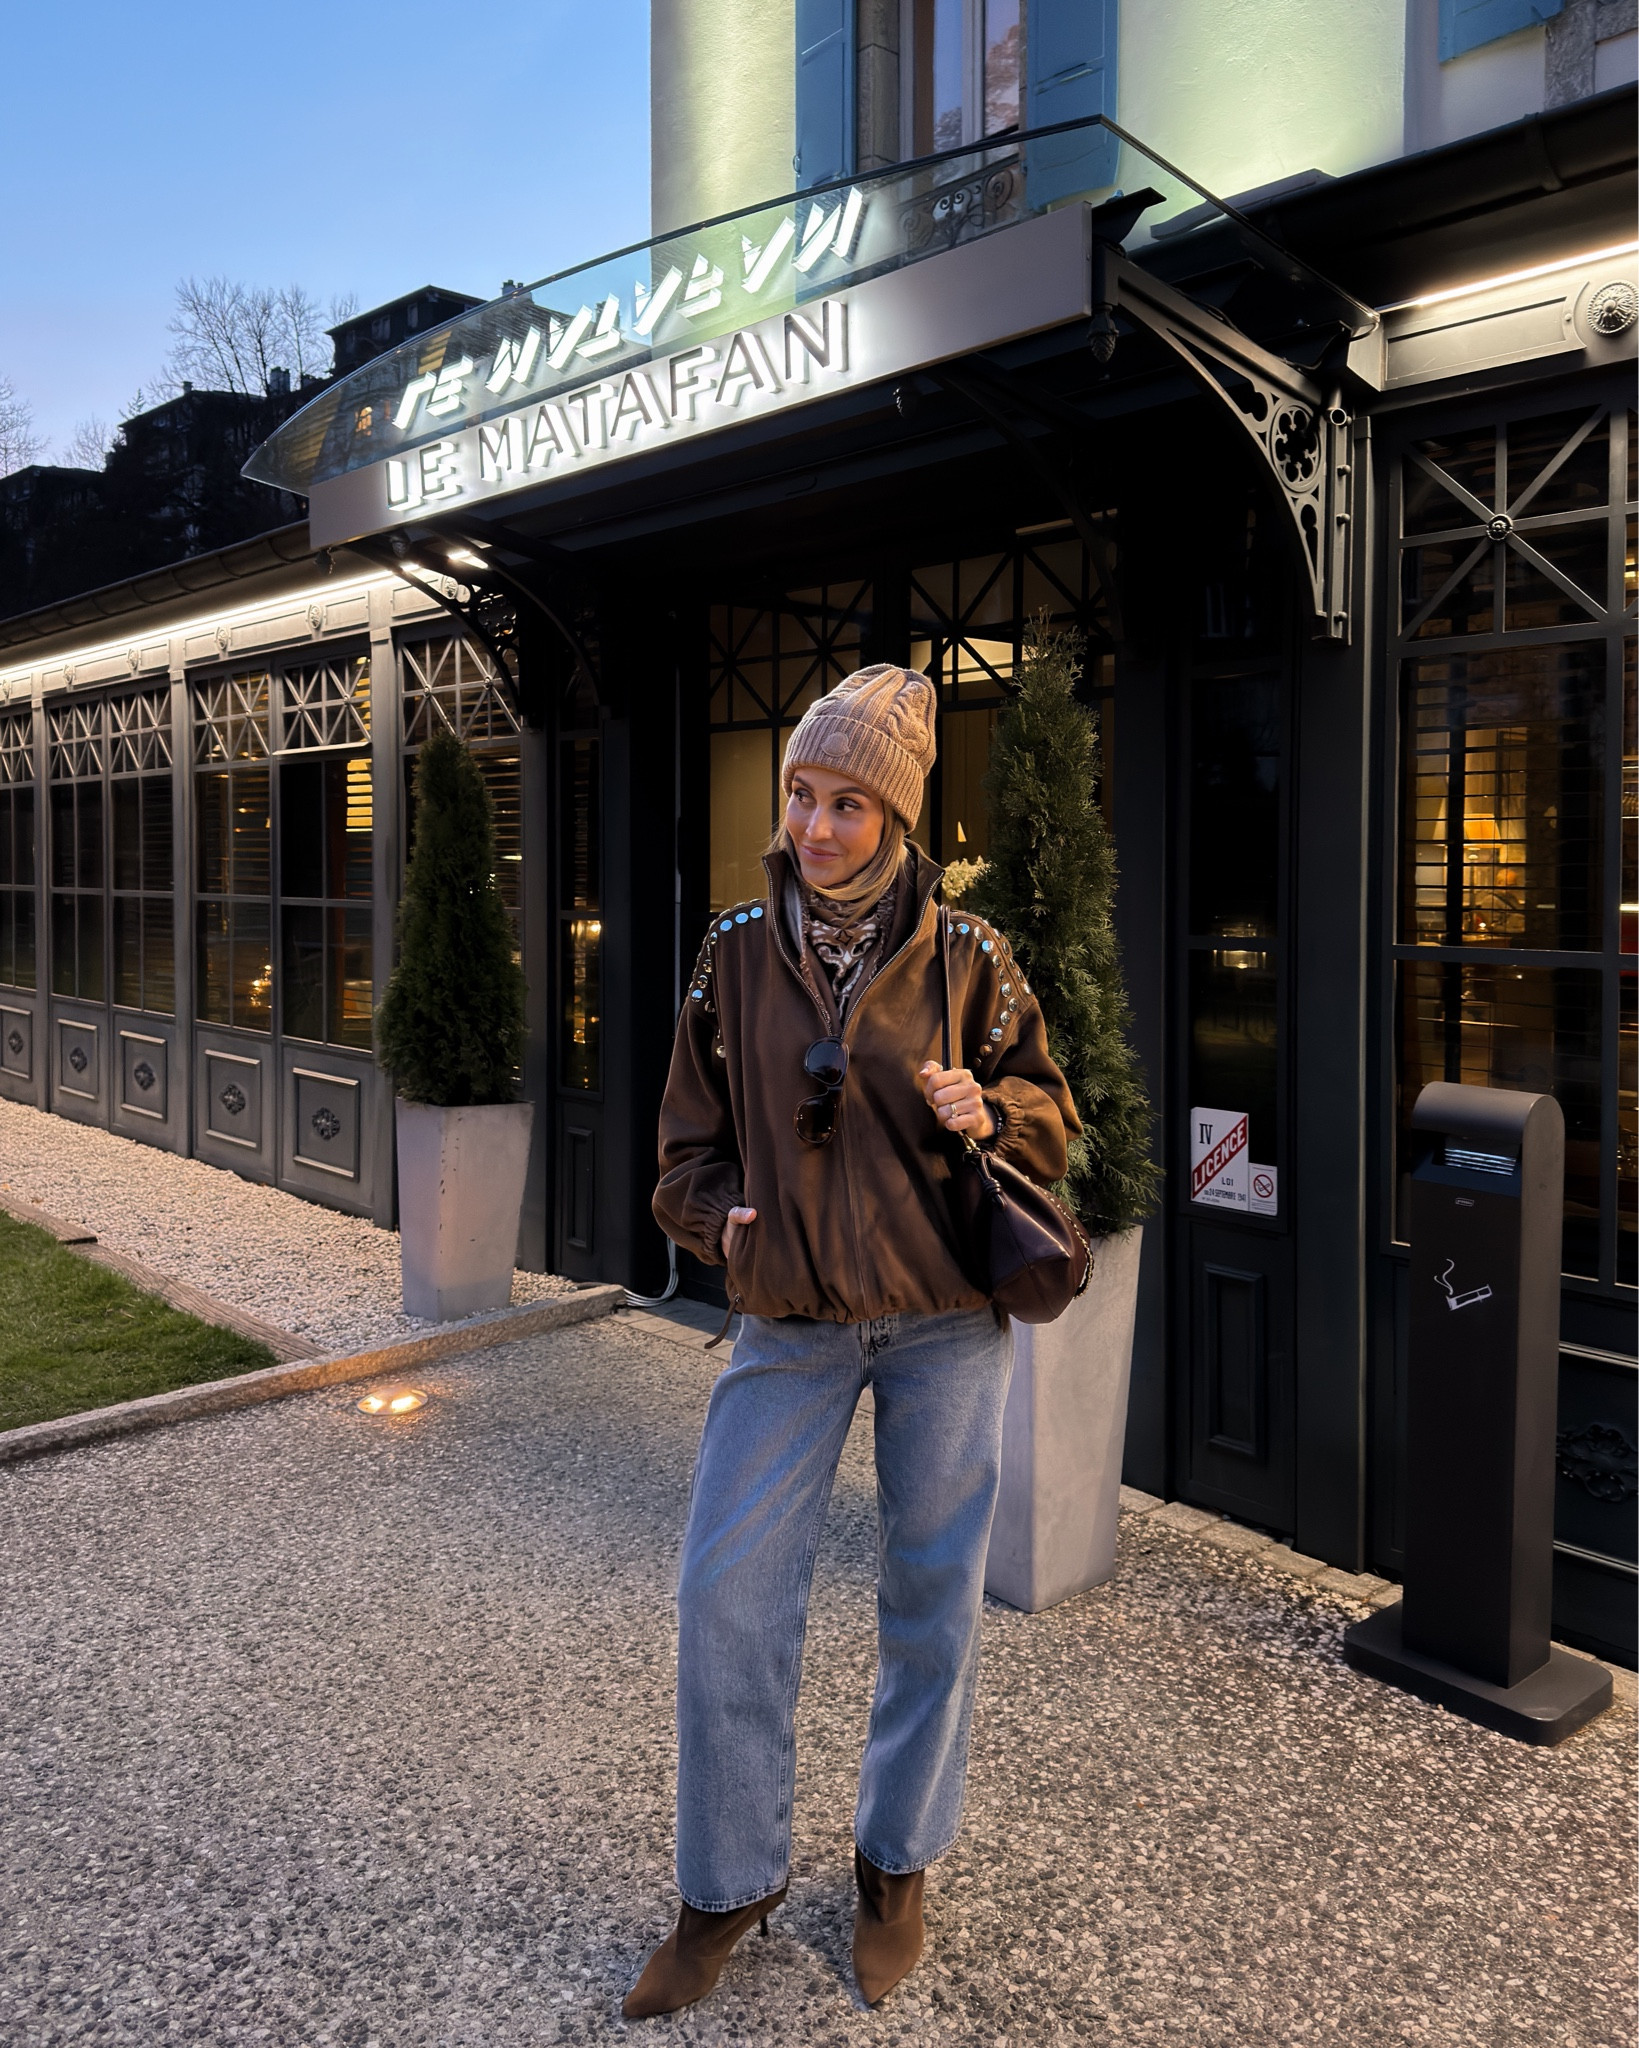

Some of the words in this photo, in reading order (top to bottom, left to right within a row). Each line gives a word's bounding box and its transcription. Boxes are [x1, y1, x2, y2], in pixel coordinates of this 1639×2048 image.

[385, 441, 463, 512] LE
[478, 299, 849, 482] MATAFAN
[1199, 1122, 1213, 1145] IV
[1193, 1122, 1246, 1193] LICENCE
[1221, 1176, 1234, 1187] LOI
